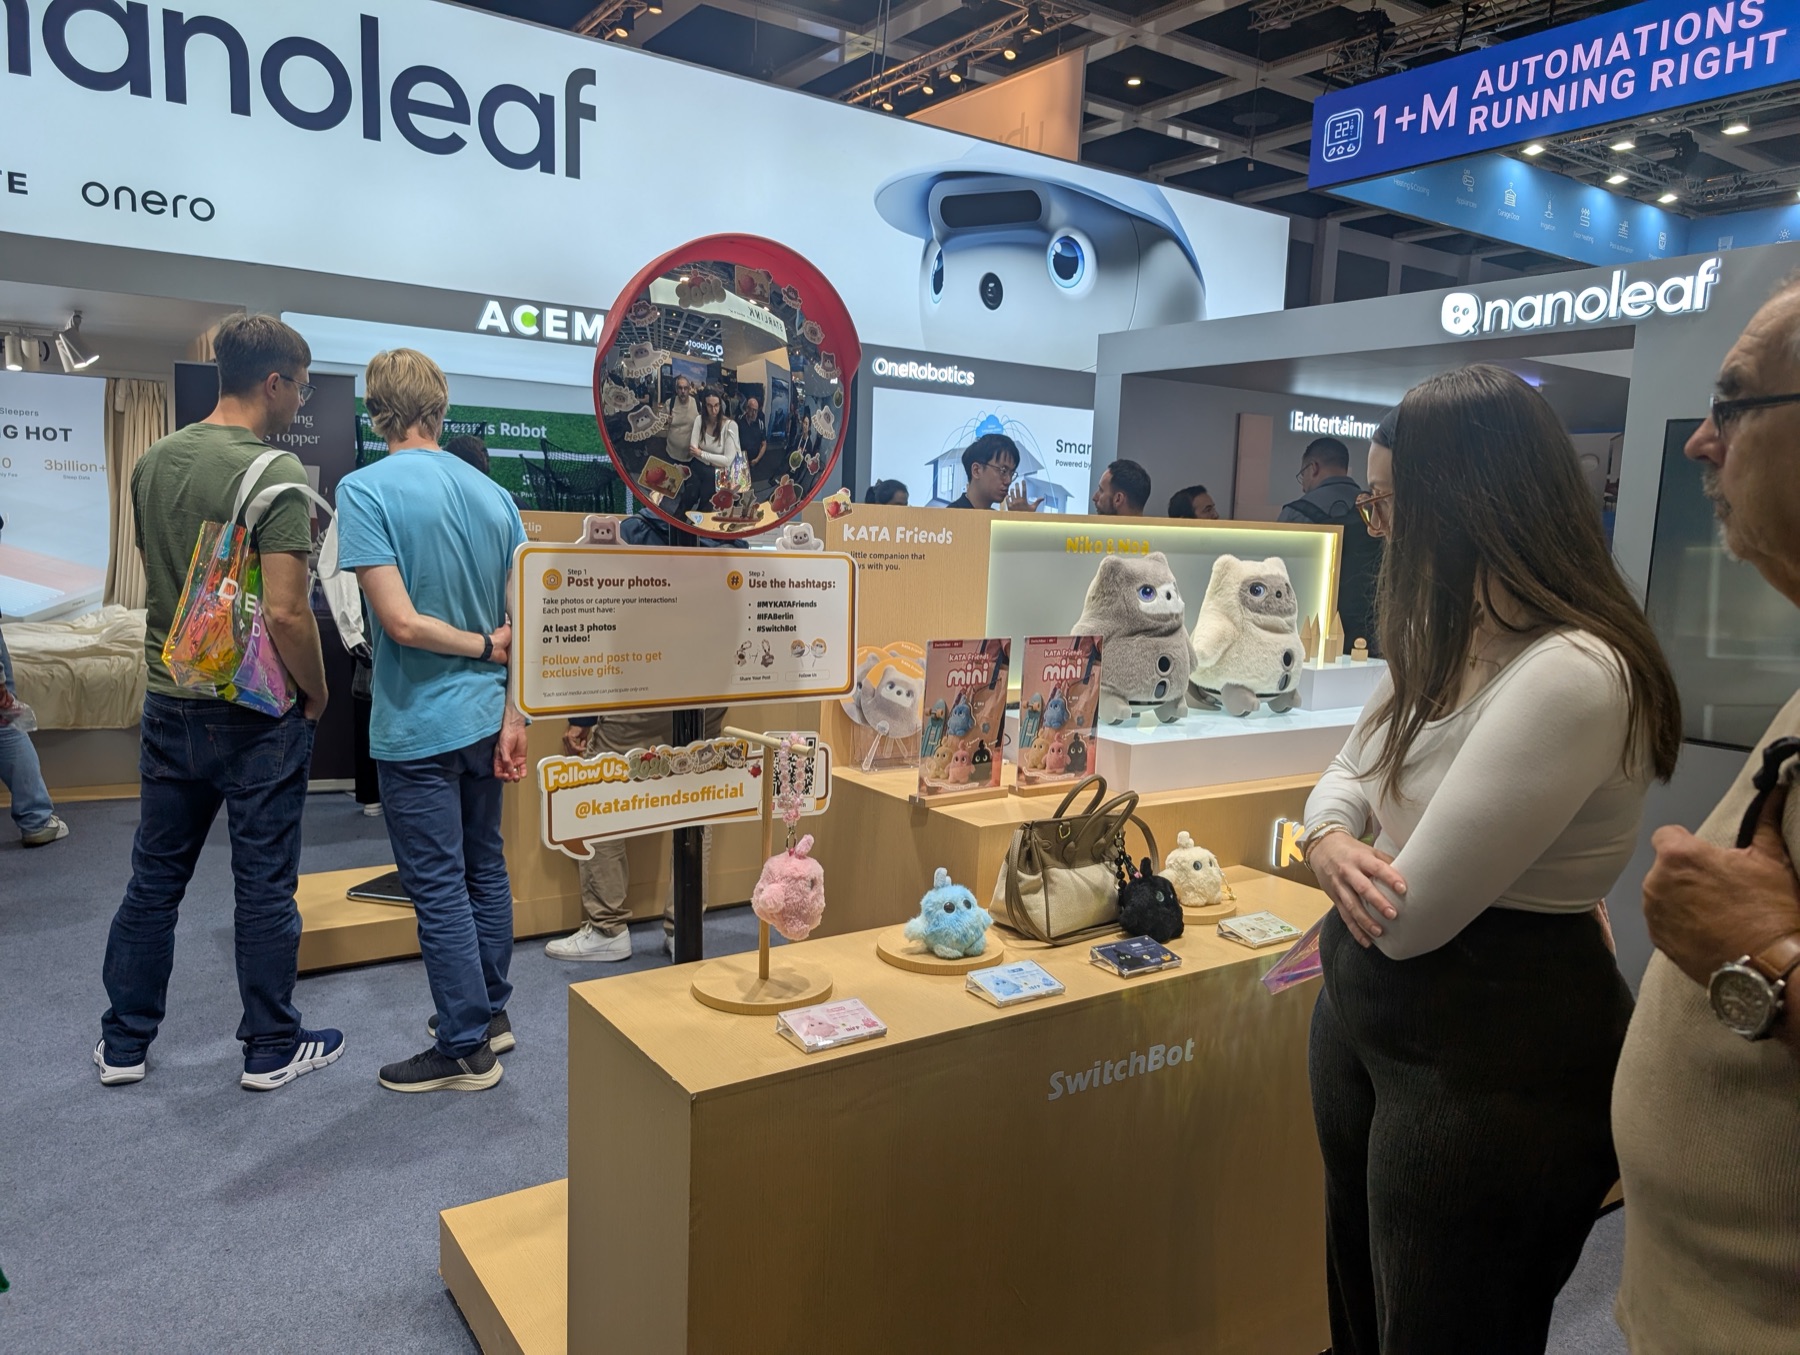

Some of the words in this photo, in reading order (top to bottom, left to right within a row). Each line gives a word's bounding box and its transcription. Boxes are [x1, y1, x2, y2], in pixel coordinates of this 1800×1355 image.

[1472, 0, 1766, 100] AUTOMATIONS
[1468, 67, 1637, 135] RUNNING
[1650, 28, 1788, 92] RIGHT
[0, 0, 597, 180] anoleaf
[81, 181, 216, 222] onero
[1483, 257, 1720, 332] nanoleaf
[873, 357, 975, 387] OneRobotics
[0, 424, 18, 439] G
[25, 425, 73, 442] HOT
[500, 422, 548, 438] Robot
[44, 459, 107, 473] 3billion+
[1055, 459, 1083, 468] Powered
[843, 523, 891, 542] KATA
[895, 526, 953, 545] Friends
[1066, 536, 1103, 554] Niko
[1118, 538, 1150, 556] Noa
[850, 551, 868, 560] little
[869, 552, 909, 561] companion
[567, 568, 582, 576] Step
[867, 561, 883, 570] with
[885, 562, 901, 571] you.
[748, 570, 761, 578] Step
[567, 576, 595, 588] Post
[597, 577, 625, 590] your
[627, 575, 672, 589] photos.
[748, 578, 768, 589] Use
[770, 578, 787, 589] the
[788, 578, 836, 591] hashtags:
[542, 597, 559, 605] Take
[560, 596, 585, 608] photos
[594, 597, 621, 607] capture
[621, 598, 637, 607] your
[638, 596, 678, 604] interactions!
[757, 599, 818, 608] #MYKATAFriends
[542, 606, 560, 615] Each
[561, 607, 577, 616] post
[577, 606, 595, 614] must
[596, 605, 616, 614] have:
[757, 611, 795, 621] #IFABerlin
[542, 623, 554, 633] At
[555, 623, 577, 632] least
[579, 623, 585, 632] 3
[586, 622, 617, 633] photos
[756, 623, 798, 633] #SwitchBot
[542, 635, 553, 644] or
[554, 635, 560, 643] 1
[562, 633, 591, 643] video!
[541, 653, 580, 666] Follow
[582, 652, 604, 664] and
[606, 651, 630, 665] post
[632, 651, 643, 662] to
[645, 650, 662, 664] get
[541, 665, 594, 679] exclusive
[596, 664, 624, 678] gifts.
[947, 661, 990, 687] mini
[1043, 658, 1082, 682] mini
[547, 764, 601, 787] Follow
[575, 782, 744, 820] @katafriendsofficial
[1048, 1037, 1195, 1101] SwitchBot
